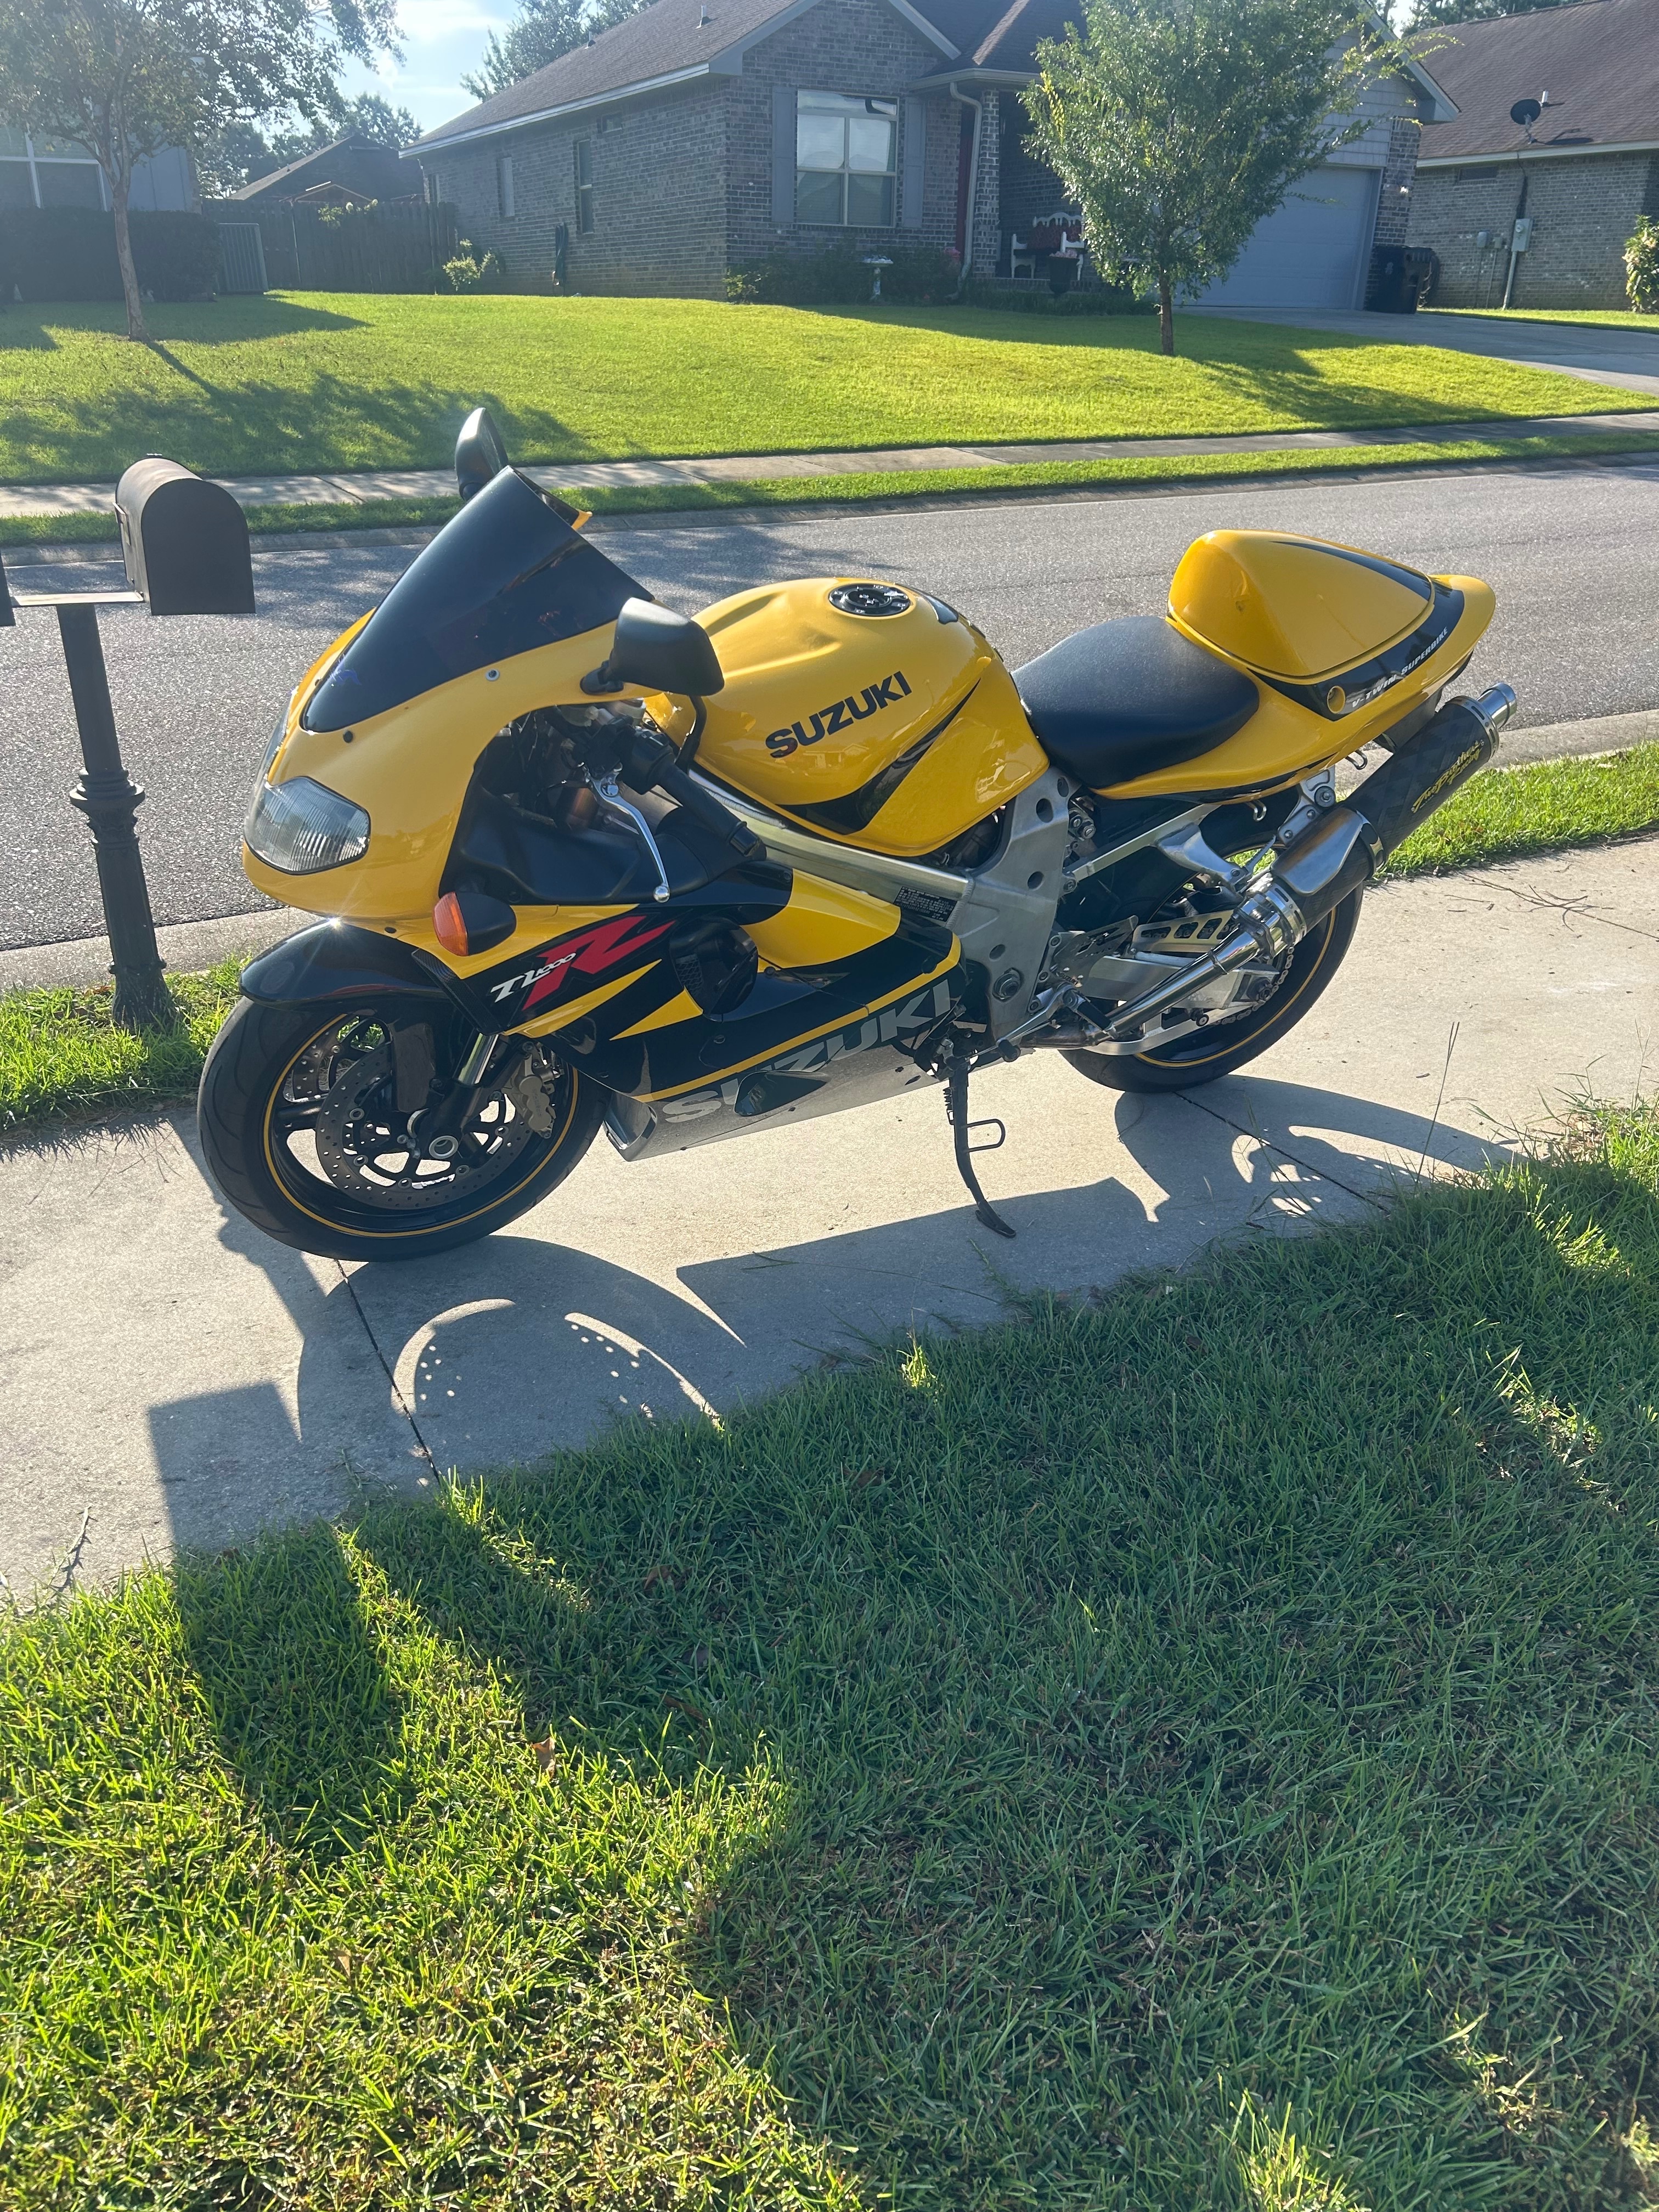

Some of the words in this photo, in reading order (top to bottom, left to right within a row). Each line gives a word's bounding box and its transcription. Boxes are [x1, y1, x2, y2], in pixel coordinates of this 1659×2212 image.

[1351, 674, 1397, 708] V-TWIN
[1401, 626, 1448, 675] SUPERBIKE
[765, 671, 912, 759] SUZUKI
